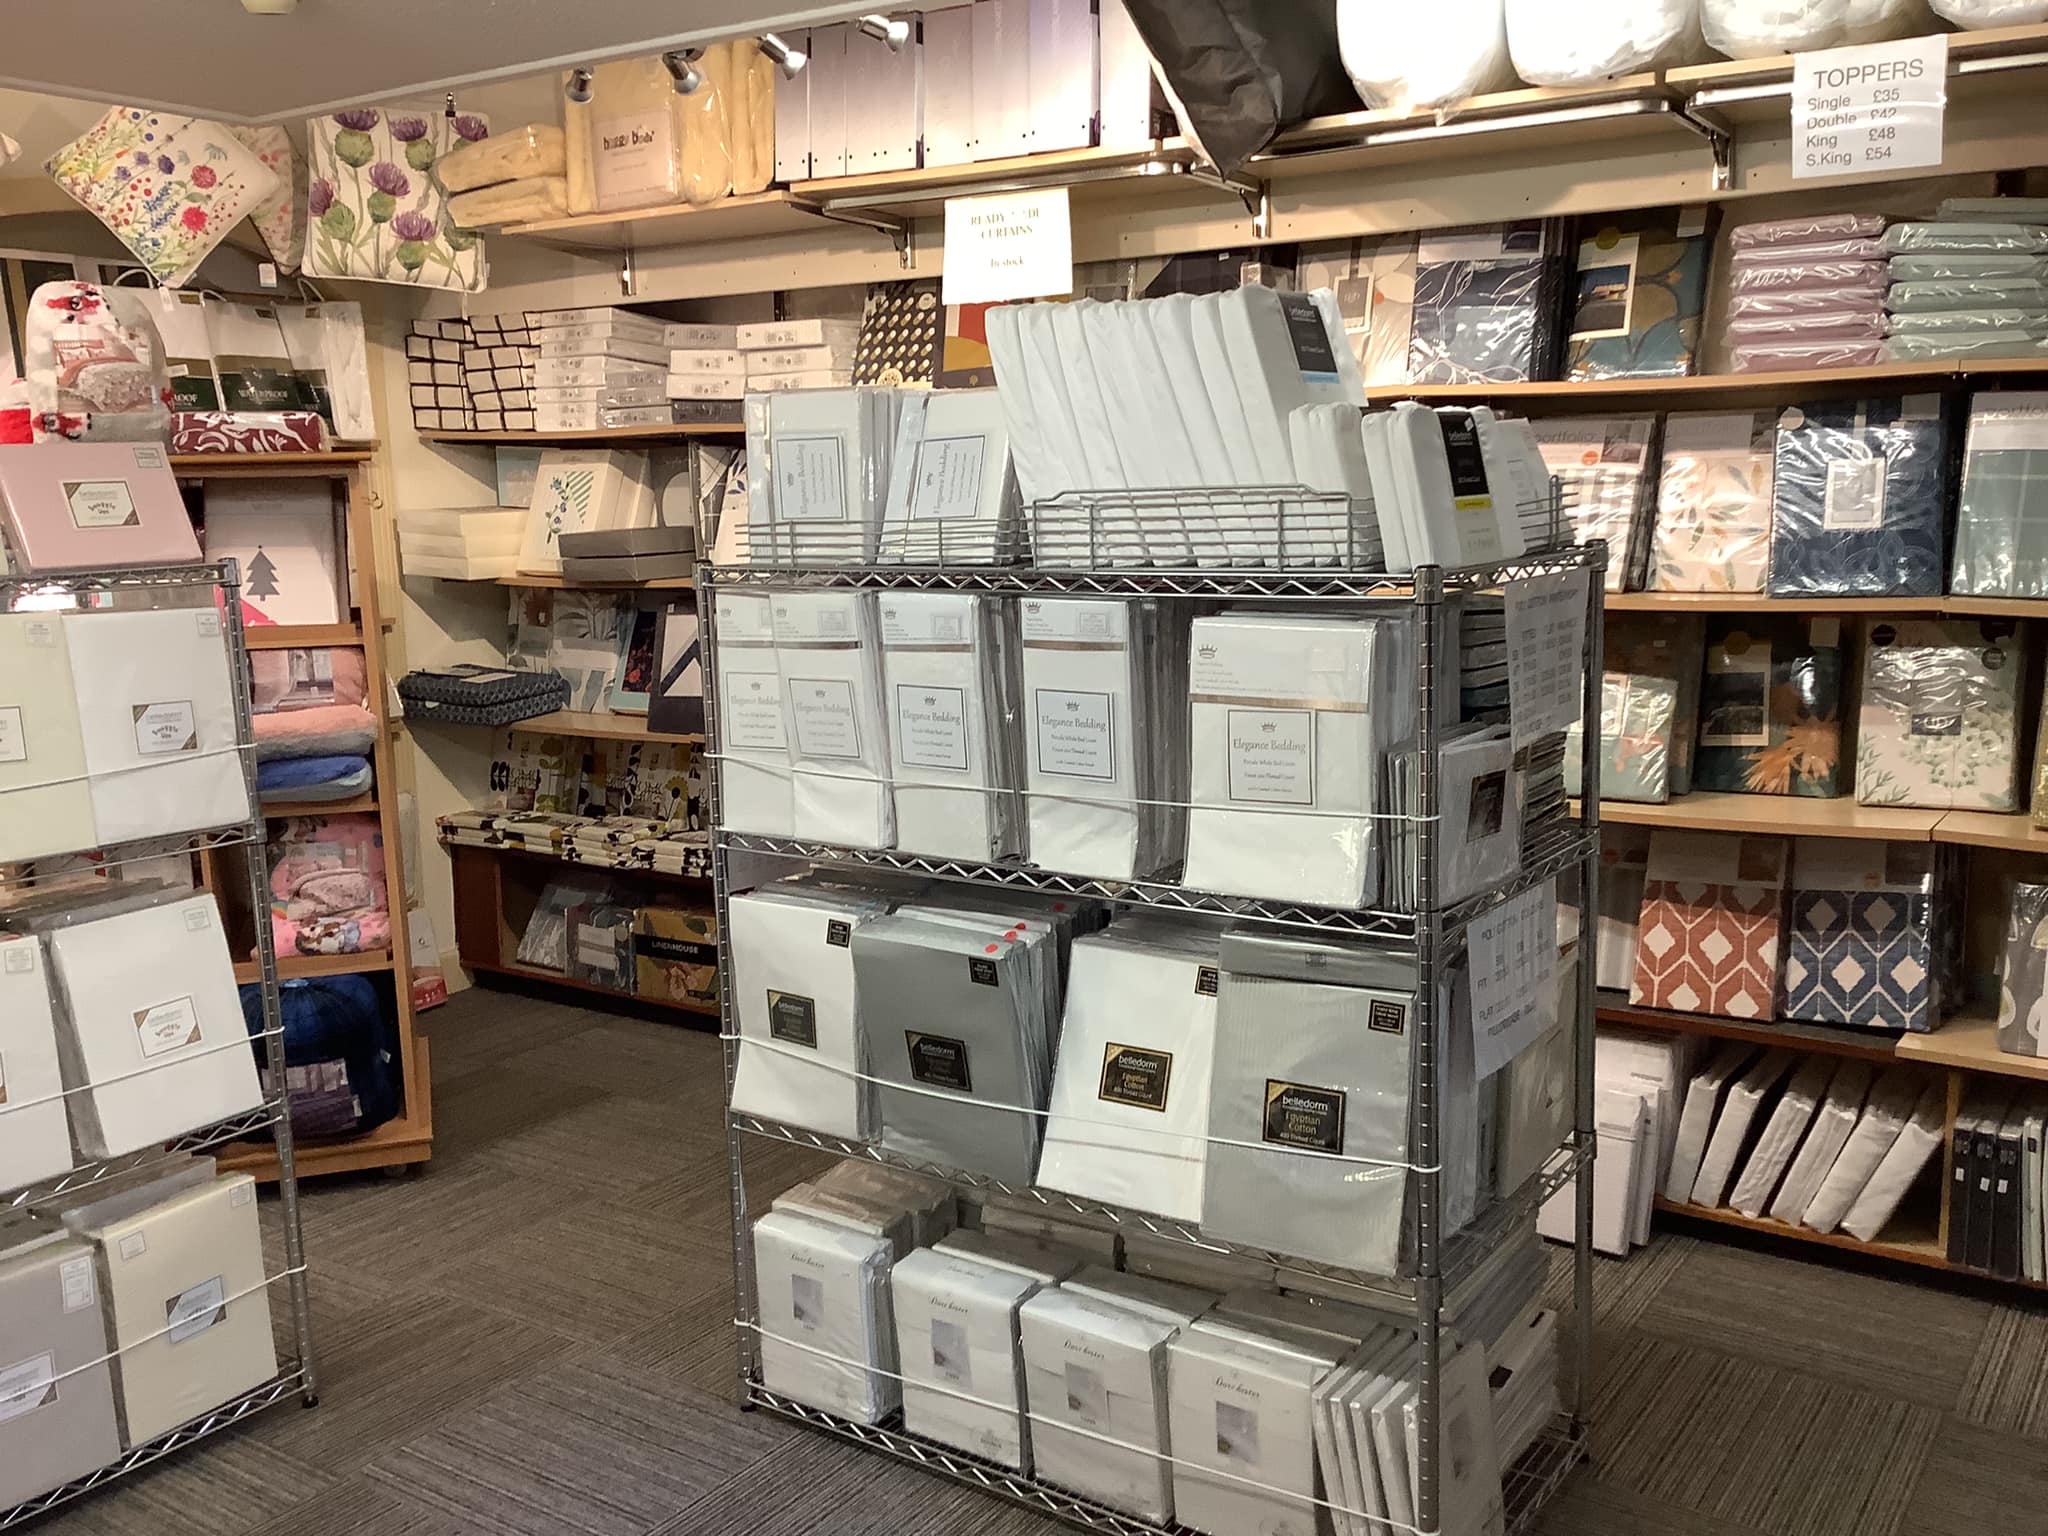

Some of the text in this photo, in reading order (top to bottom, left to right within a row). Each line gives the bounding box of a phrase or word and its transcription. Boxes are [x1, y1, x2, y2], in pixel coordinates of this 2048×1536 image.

[1814, 58, 1924, 89] TOPPERS
[1807, 88, 1900, 111] Single £35
[1806, 111, 1857, 130] Double
[1806, 126, 1896, 149] King £48
[1805, 146, 1891, 167] S.King £54
[1042, 715, 1106, 732] Elegance Bedding
[1233, 738, 1306, 755] Elegance Bedding
[1118, 1055, 1158, 1070] belledorm
[1282, 1095, 1328, 1111] belledorm
[1285, 1111, 1320, 1126] Egyptian
[1289, 1122, 1317, 1135] Cotton
